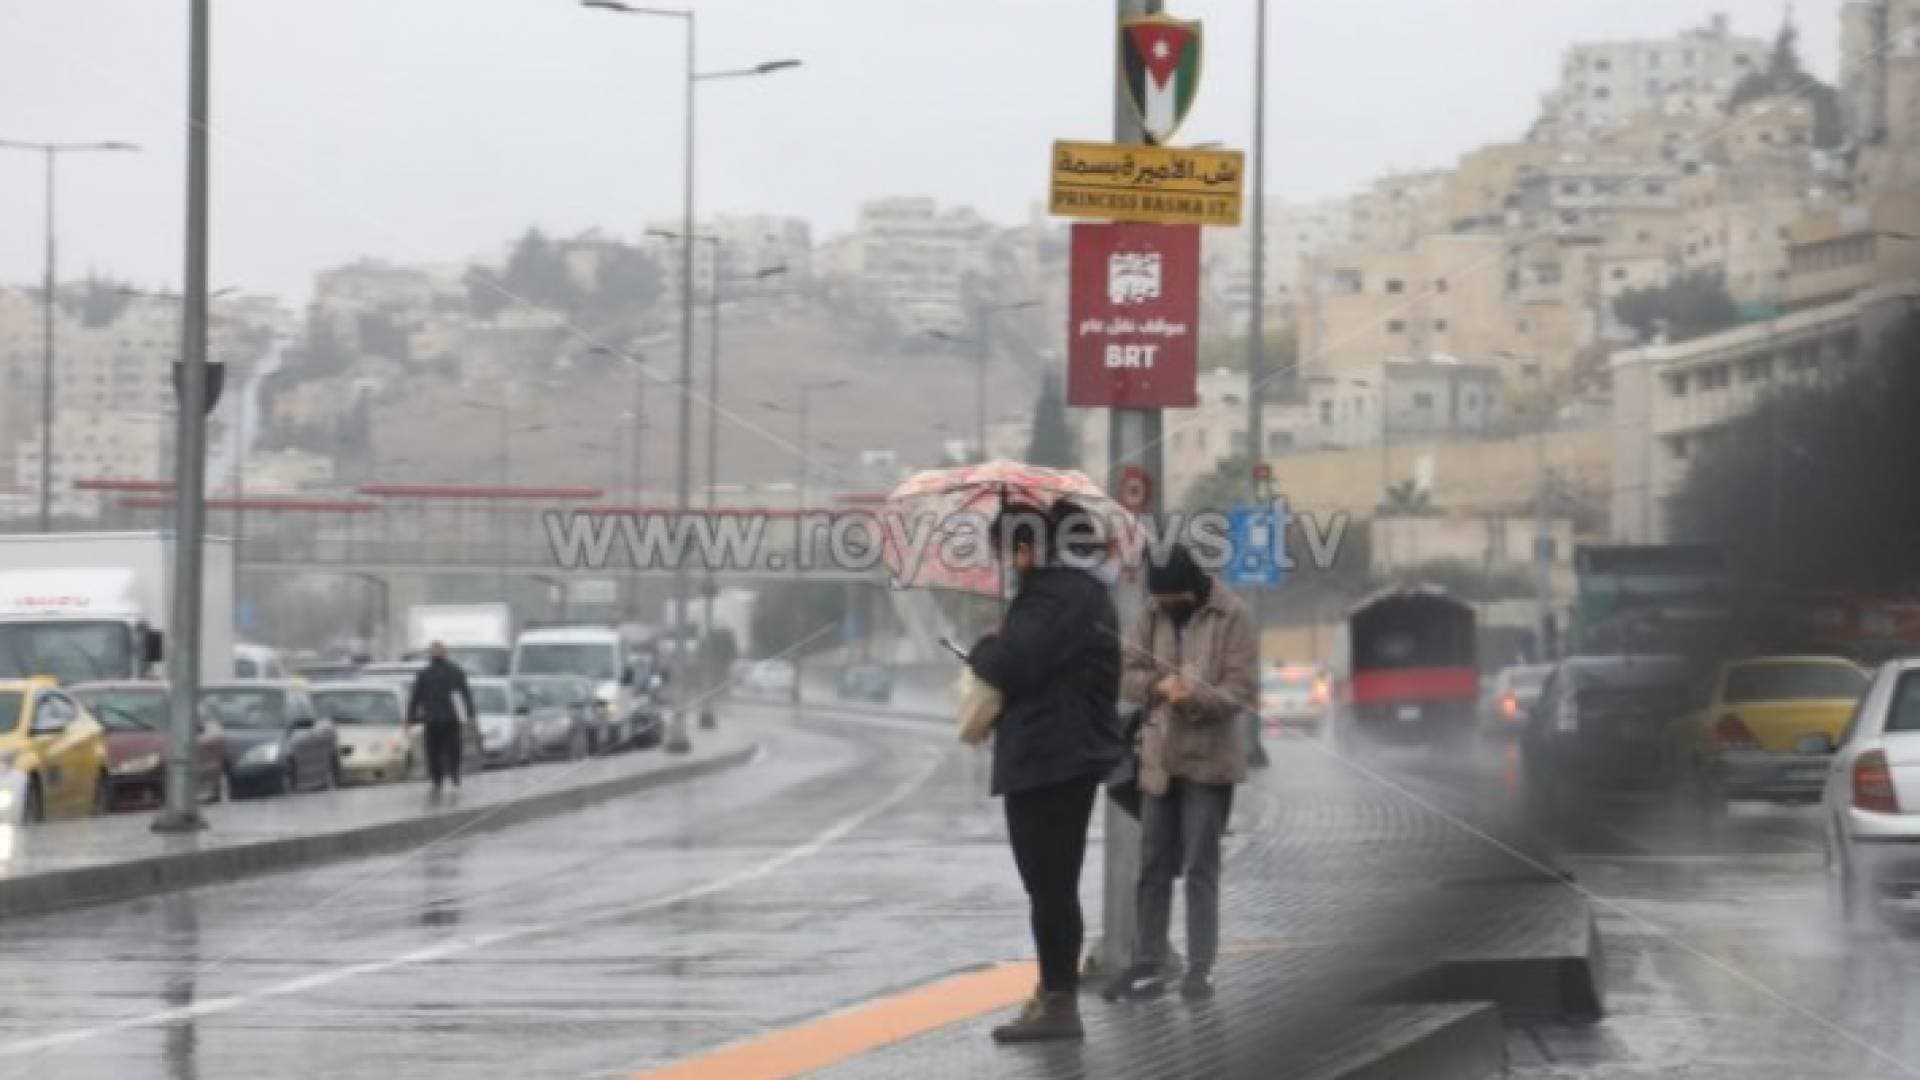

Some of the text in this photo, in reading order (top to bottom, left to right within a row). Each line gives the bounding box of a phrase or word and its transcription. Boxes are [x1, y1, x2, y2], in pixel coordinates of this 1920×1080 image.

[1055, 189, 1138, 209] PRINCESS
[1142, 195, 1203, 213] BASMA
[1079, 316, 1187, 337] موقف نقل عام
[1105, 344, 1159, 368] BRT
